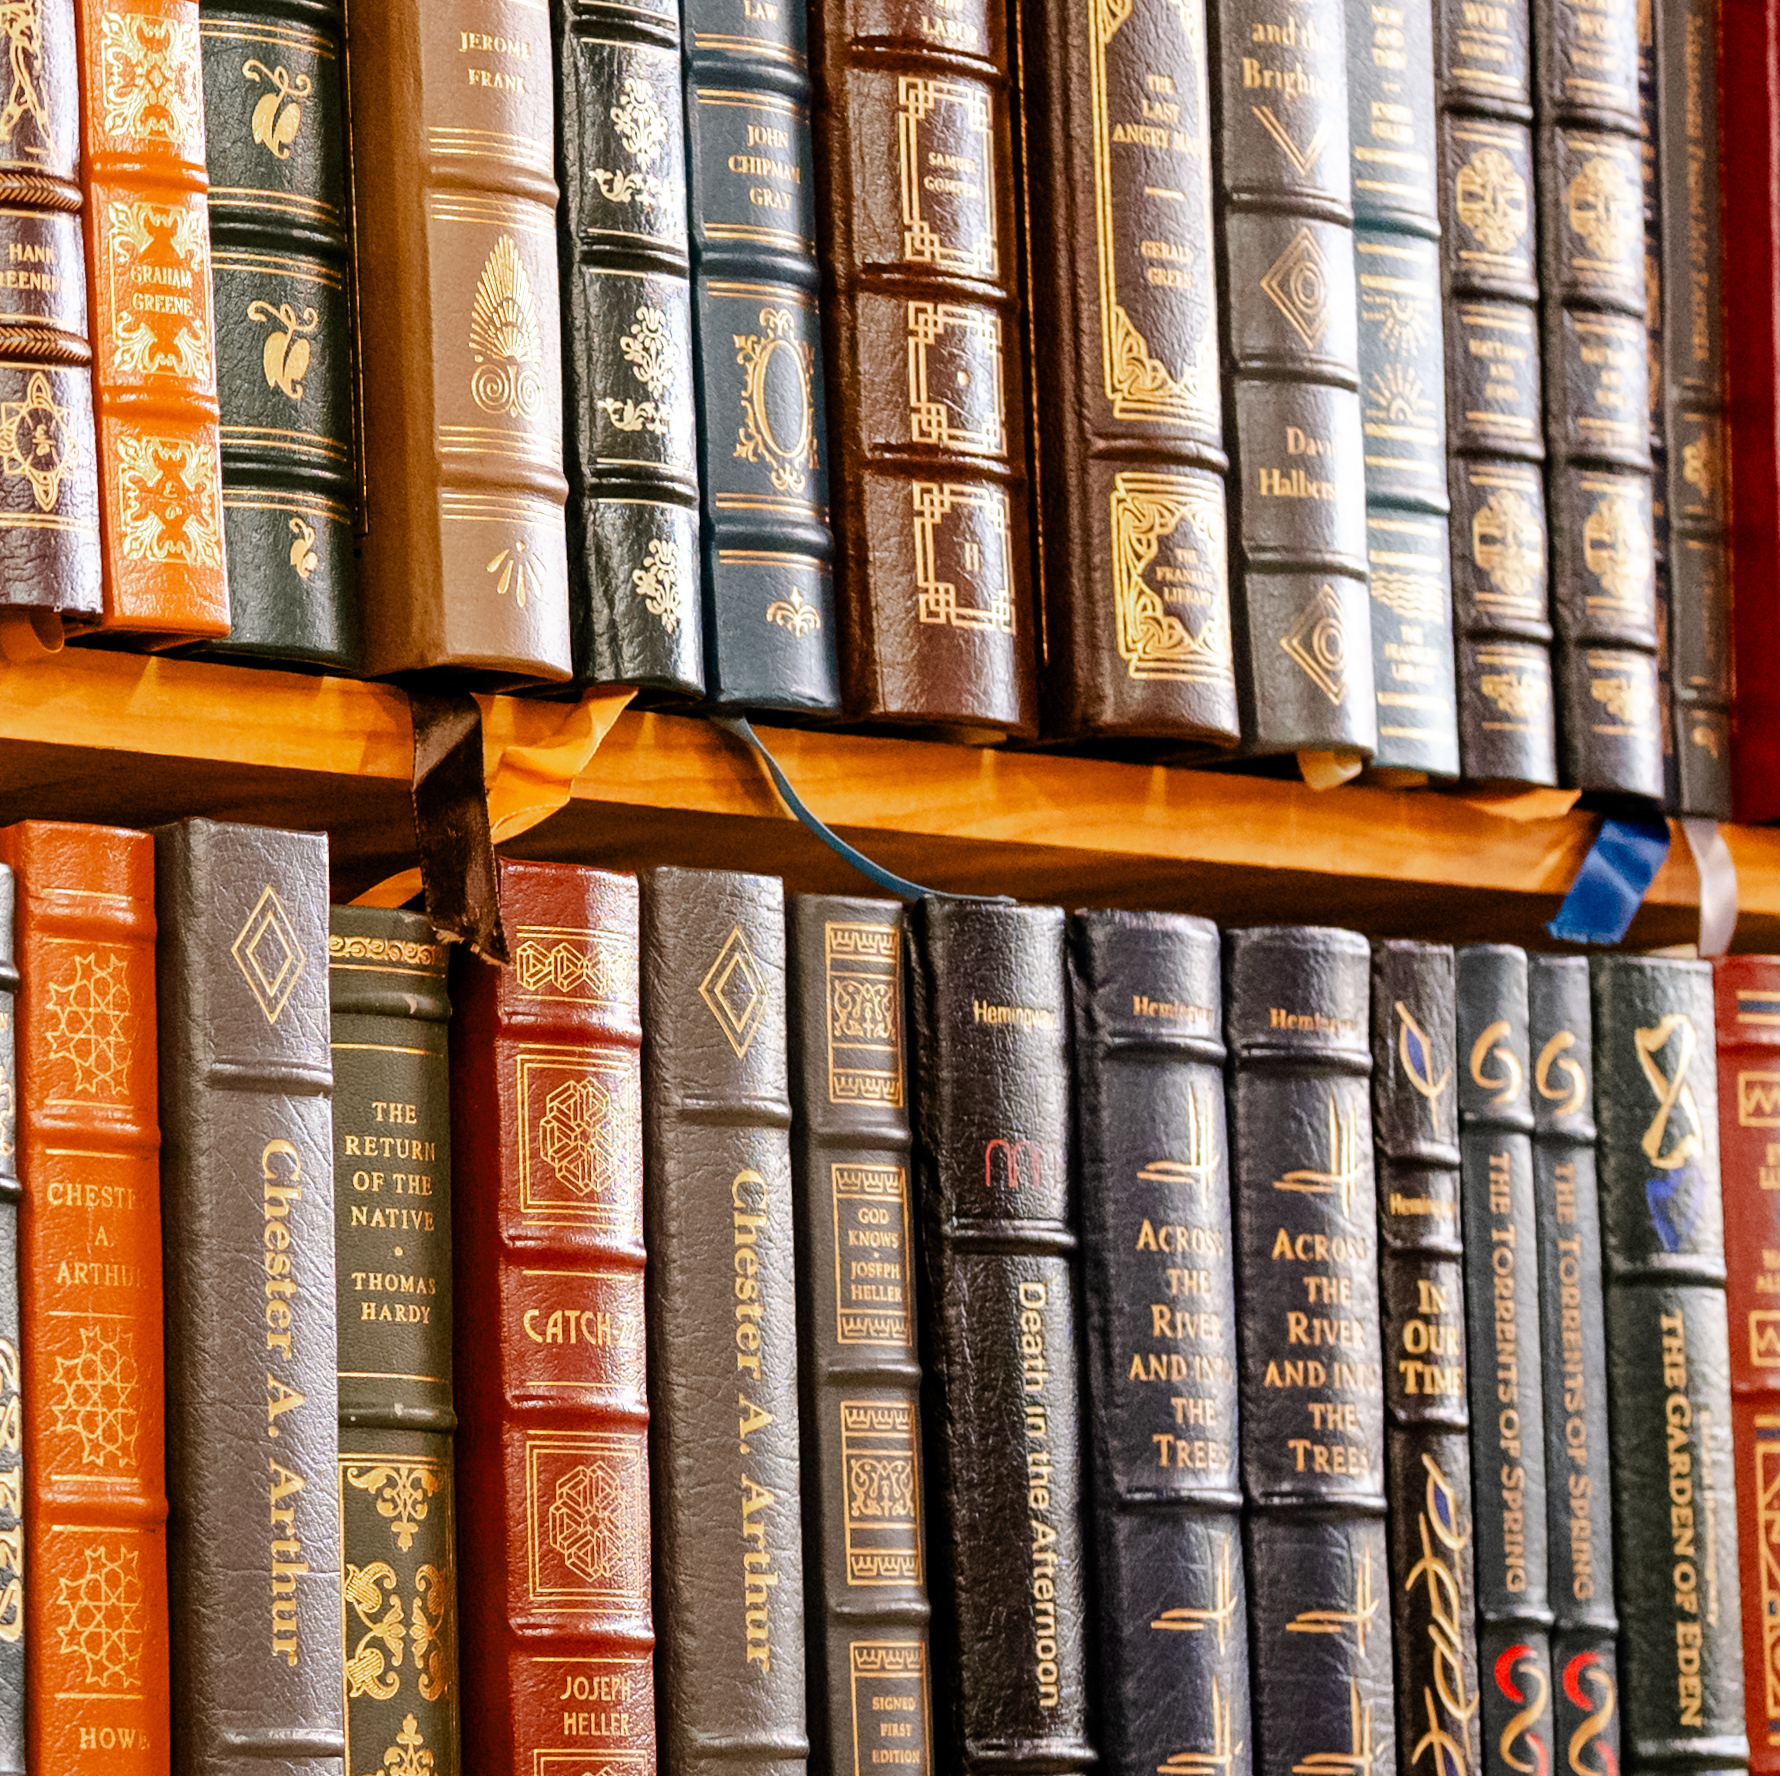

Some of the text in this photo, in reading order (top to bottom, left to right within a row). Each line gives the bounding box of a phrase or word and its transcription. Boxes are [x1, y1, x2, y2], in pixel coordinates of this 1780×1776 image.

[921, 15, 979, 44] LABOR
[459, 30, 531, 60] JEROME
[467, 67, 526, 94] FRANK
[1146, 74, 1174, 94] THE
[1142, 99, 1181, 122] LAST
[746, 125, 789, 148] JOHN
[1112, 123, 1169, 148] ANGRY
[727, 153, 800, 183] CHIPMAN
[749, 186, 792, 210] GRAY
[8, 244, 56, 265] HANK
[129, 265, 192, 288] GRAHAM
[131, 292, 192, 315] GREENE
[372, 1102, 416, 1124] THE
[344, 1136, 436, 1162] RETURN
[352, 1172, 432, 1196] OF THE
[350, 1206, 433, 1232] NATIVE
[858, 1208, 888, 1226] GOD
[848, 1230, 899, 1249] KNOWS
[1272, 1228, 1366, 1261] ACROSS
[851, 1260, 900, 1280] JOSEPH
[351, 1272, 436, 1295] THOMAS
[851, 1282, 901, 1302] HELLER
[1304, 1276, 1352, 1304] THE
[1417, 1280, 1446, 1313] IN
[360, 1302, 430, 1324] HARDY
[1287, 1313, 1364, 1348] RIVER
[1402, 1320, 1459, 1354] OUR
[1264, 1362, 1325, 1388] AND
[1399, 1361, 1462, 1395] TIME
[1489, 1152, 1527, 1592] THE TORRENTS OF SPRING
[261, 1137, 309, 1668] Chester A. Arthur
[731, 1168, 778, 1673] Chester A. Arthur
[1308, 1402, 1356, 1430] THE
[1288, 1440, 1368, 1475] TREES
[1019, 1282, 1058, 1707] Death in the Afternoon
[1660, 1309, 1702, 1726] THE GARDEN OF EDEN
[560, 1675, 630, 1703] JOSEPH
[872, 1696, 916, 1713] SIGNED
[562, 1711, 629, 1737] HELLER
[880, 1721, 911, 1738] FIRST
[872, 1748, 920, 1765] EDITION
